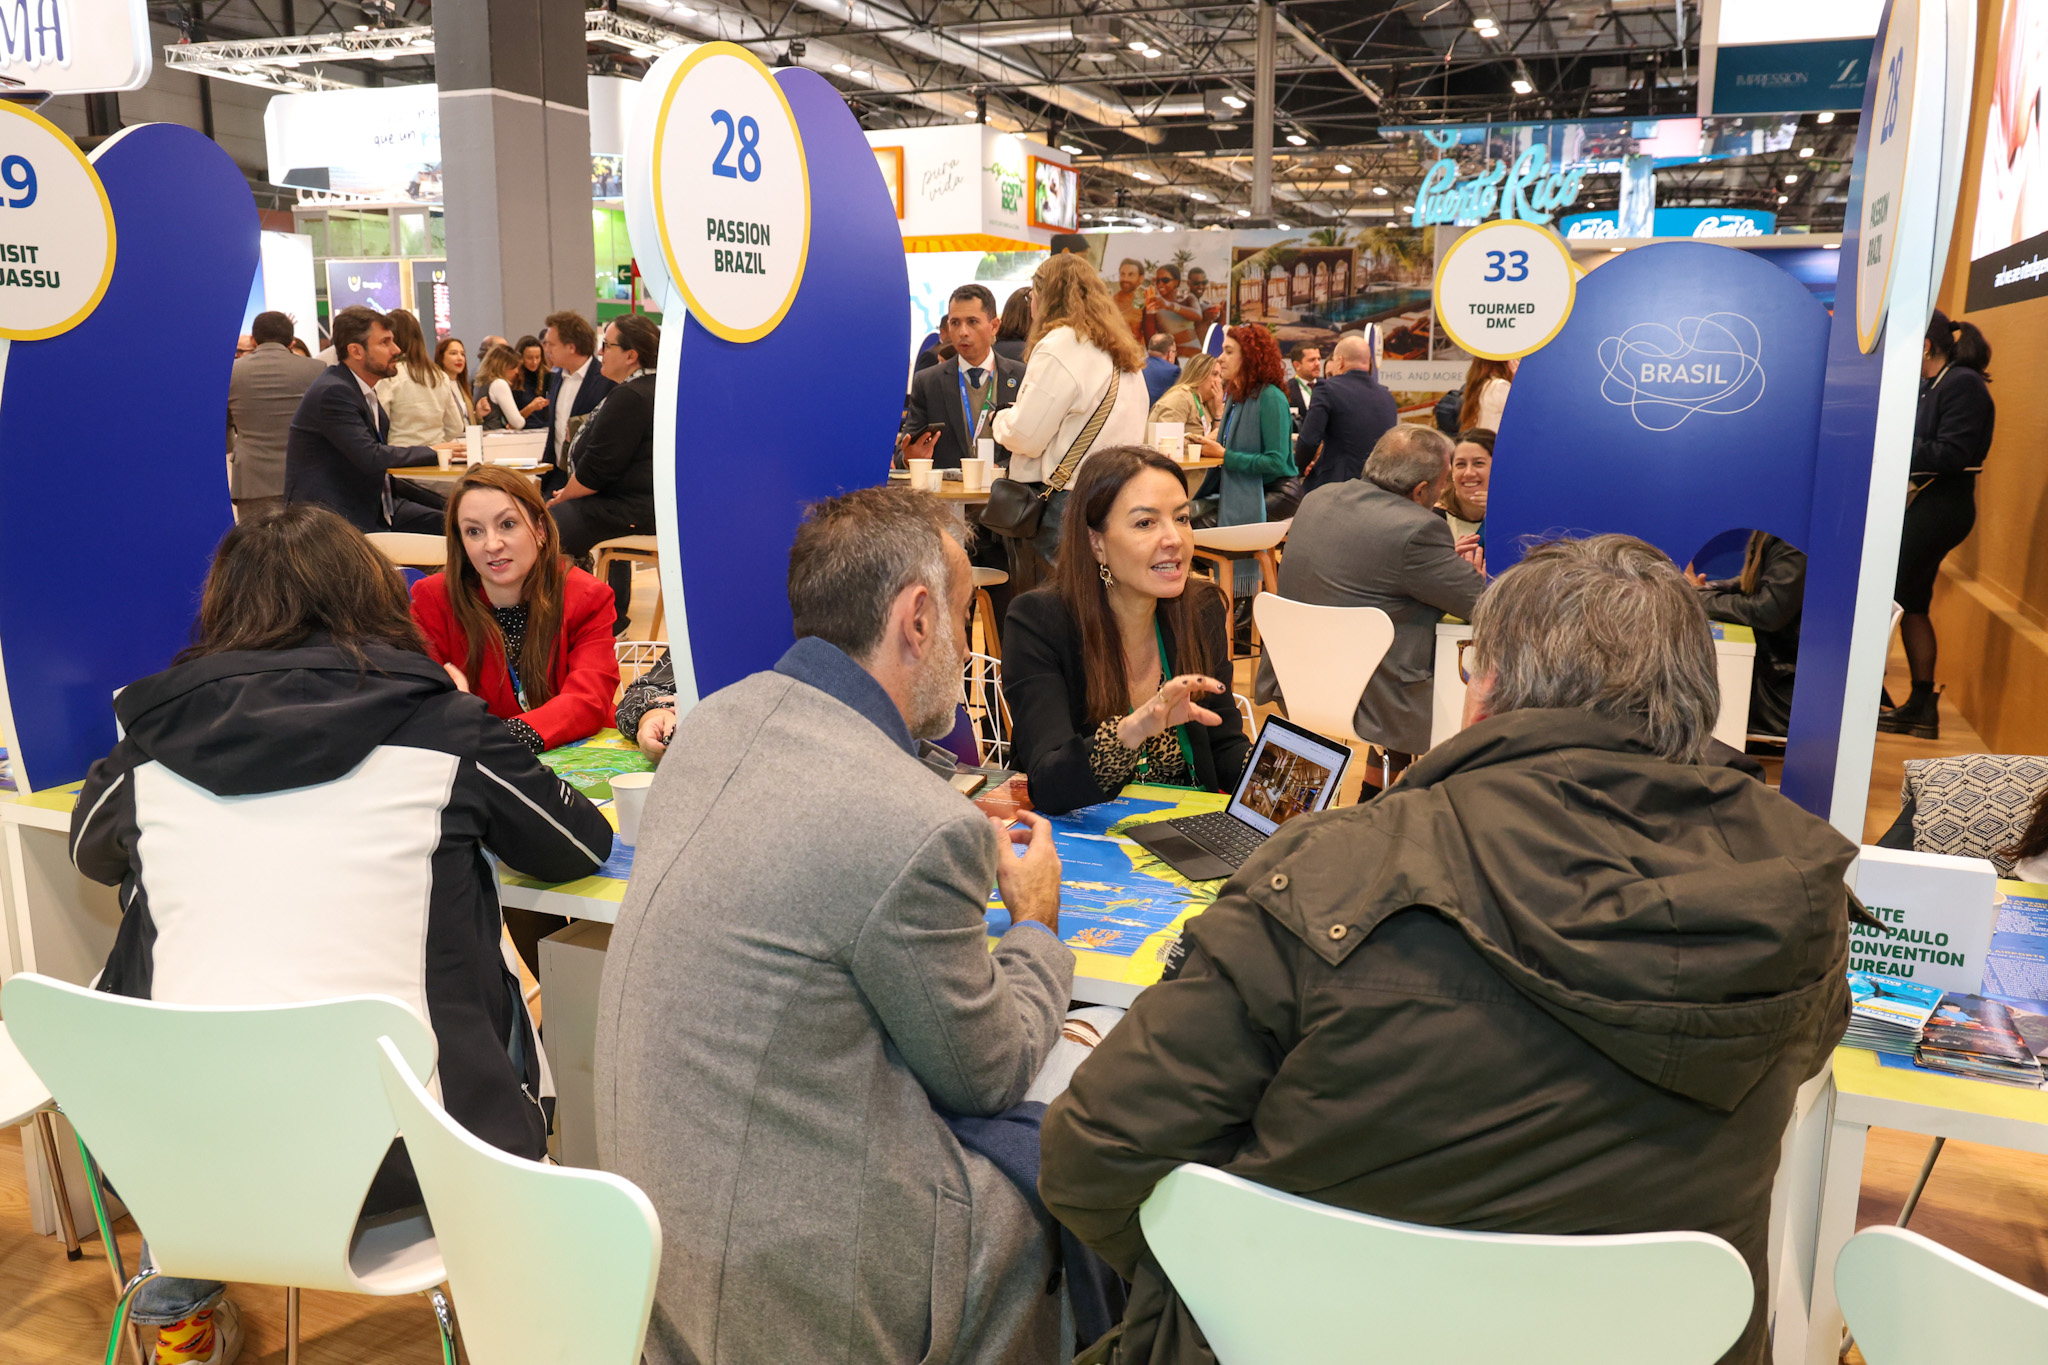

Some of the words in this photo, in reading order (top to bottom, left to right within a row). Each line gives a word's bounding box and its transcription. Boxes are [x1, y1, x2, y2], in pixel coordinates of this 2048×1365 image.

[1880, 46, 1904, 146] 28
[710, 108, 762, 183] 28
[922, 159, 960, 196] pura
[929, 172, 964, 202] vida
[1412, 158, 1507, 228] Puerto
[1500, 143, 1588, 225] Rico
[707, 217, 771, 247] PASSION
[714, 249, 767, 275] BRAZIL
[1483, 250, 1529, 282] 33
[1468, 303, 1536, 315] TOURMED
[1486, 317, 1517, 329] DMC
[1407, 371, 1431, 381] AND
[1432, 371, 1463, 381] MORE
[1640, 363, 1728, 385] BRASIL
[1885, 926, 1949, 946] PAULO
[1849, 940, 1966, 967] ONVENTION
